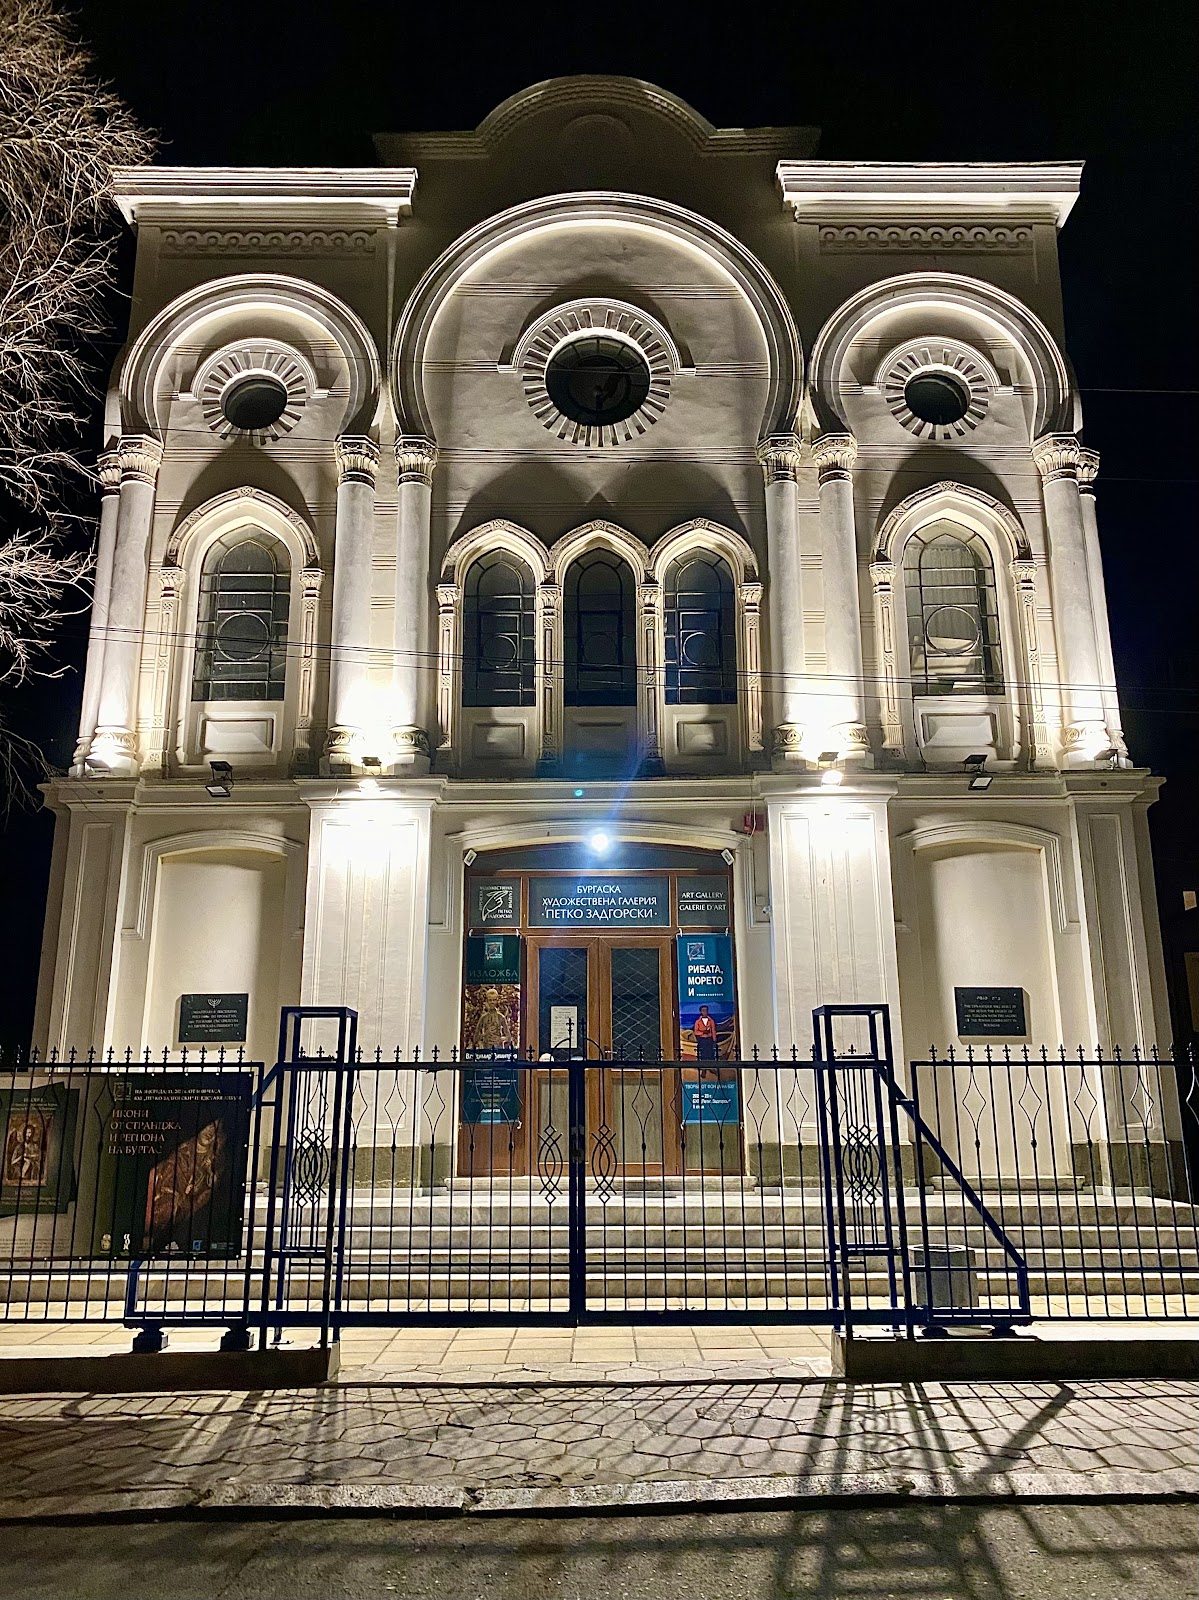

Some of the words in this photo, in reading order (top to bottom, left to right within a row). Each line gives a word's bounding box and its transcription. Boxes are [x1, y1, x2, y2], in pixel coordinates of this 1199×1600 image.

[577, 885, 621, 894] БУРГАСКА
[542, 897, 617, 907] ХУДОЖЕСТВЕНА
[618, 897, 657, 906] ГАЛЕРИЯ
[688, 965, 724, 974] РИБАТА,
[688, 976, 724, 985] МОРЕТО
[688, 987, 695, 996] И
[112, 1109, 149, 1118] ИКОНИ
